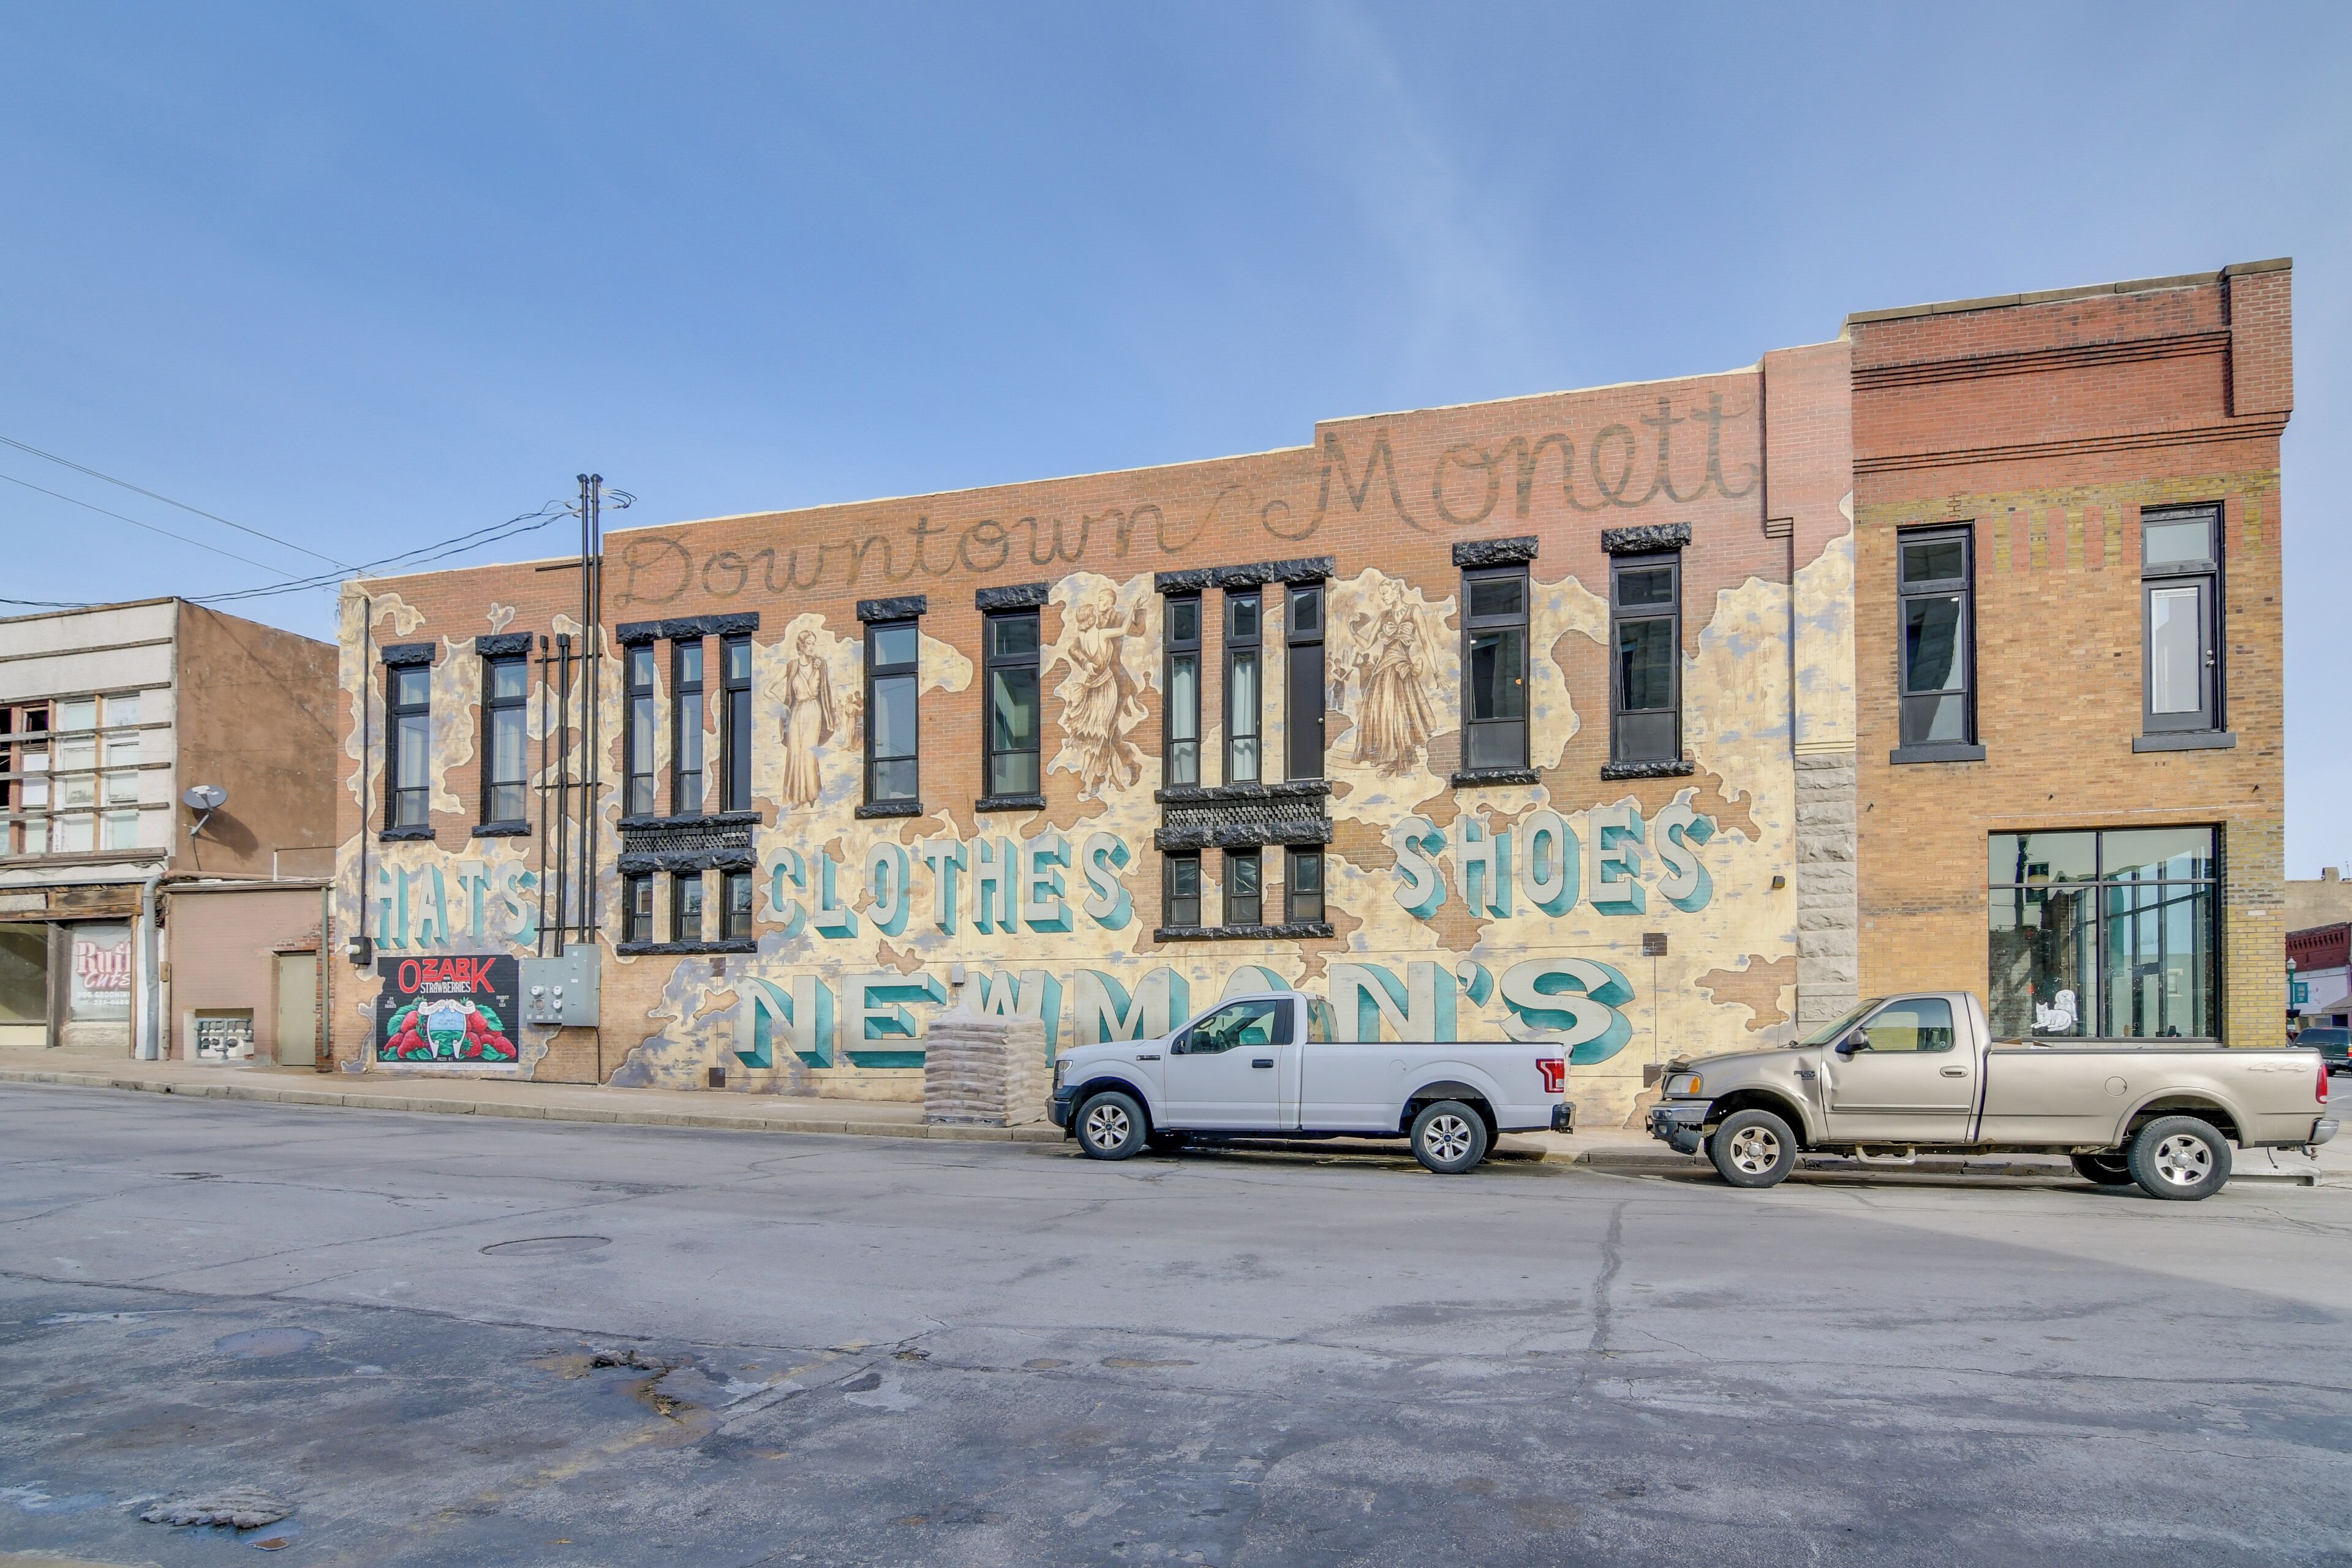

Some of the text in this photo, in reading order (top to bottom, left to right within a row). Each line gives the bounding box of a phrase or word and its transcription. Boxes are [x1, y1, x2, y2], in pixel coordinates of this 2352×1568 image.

[614, 392, 1760, 609] Downtown Monett
[373, 859, 538, 949] HATS
[761, 832, 1132, 940] CLOTHES
[1392, 804, 1716, 920] SHOES
[398, 958, 496, 993] OZARK
[420, 981, 471, 993] STRAWBERRIES
